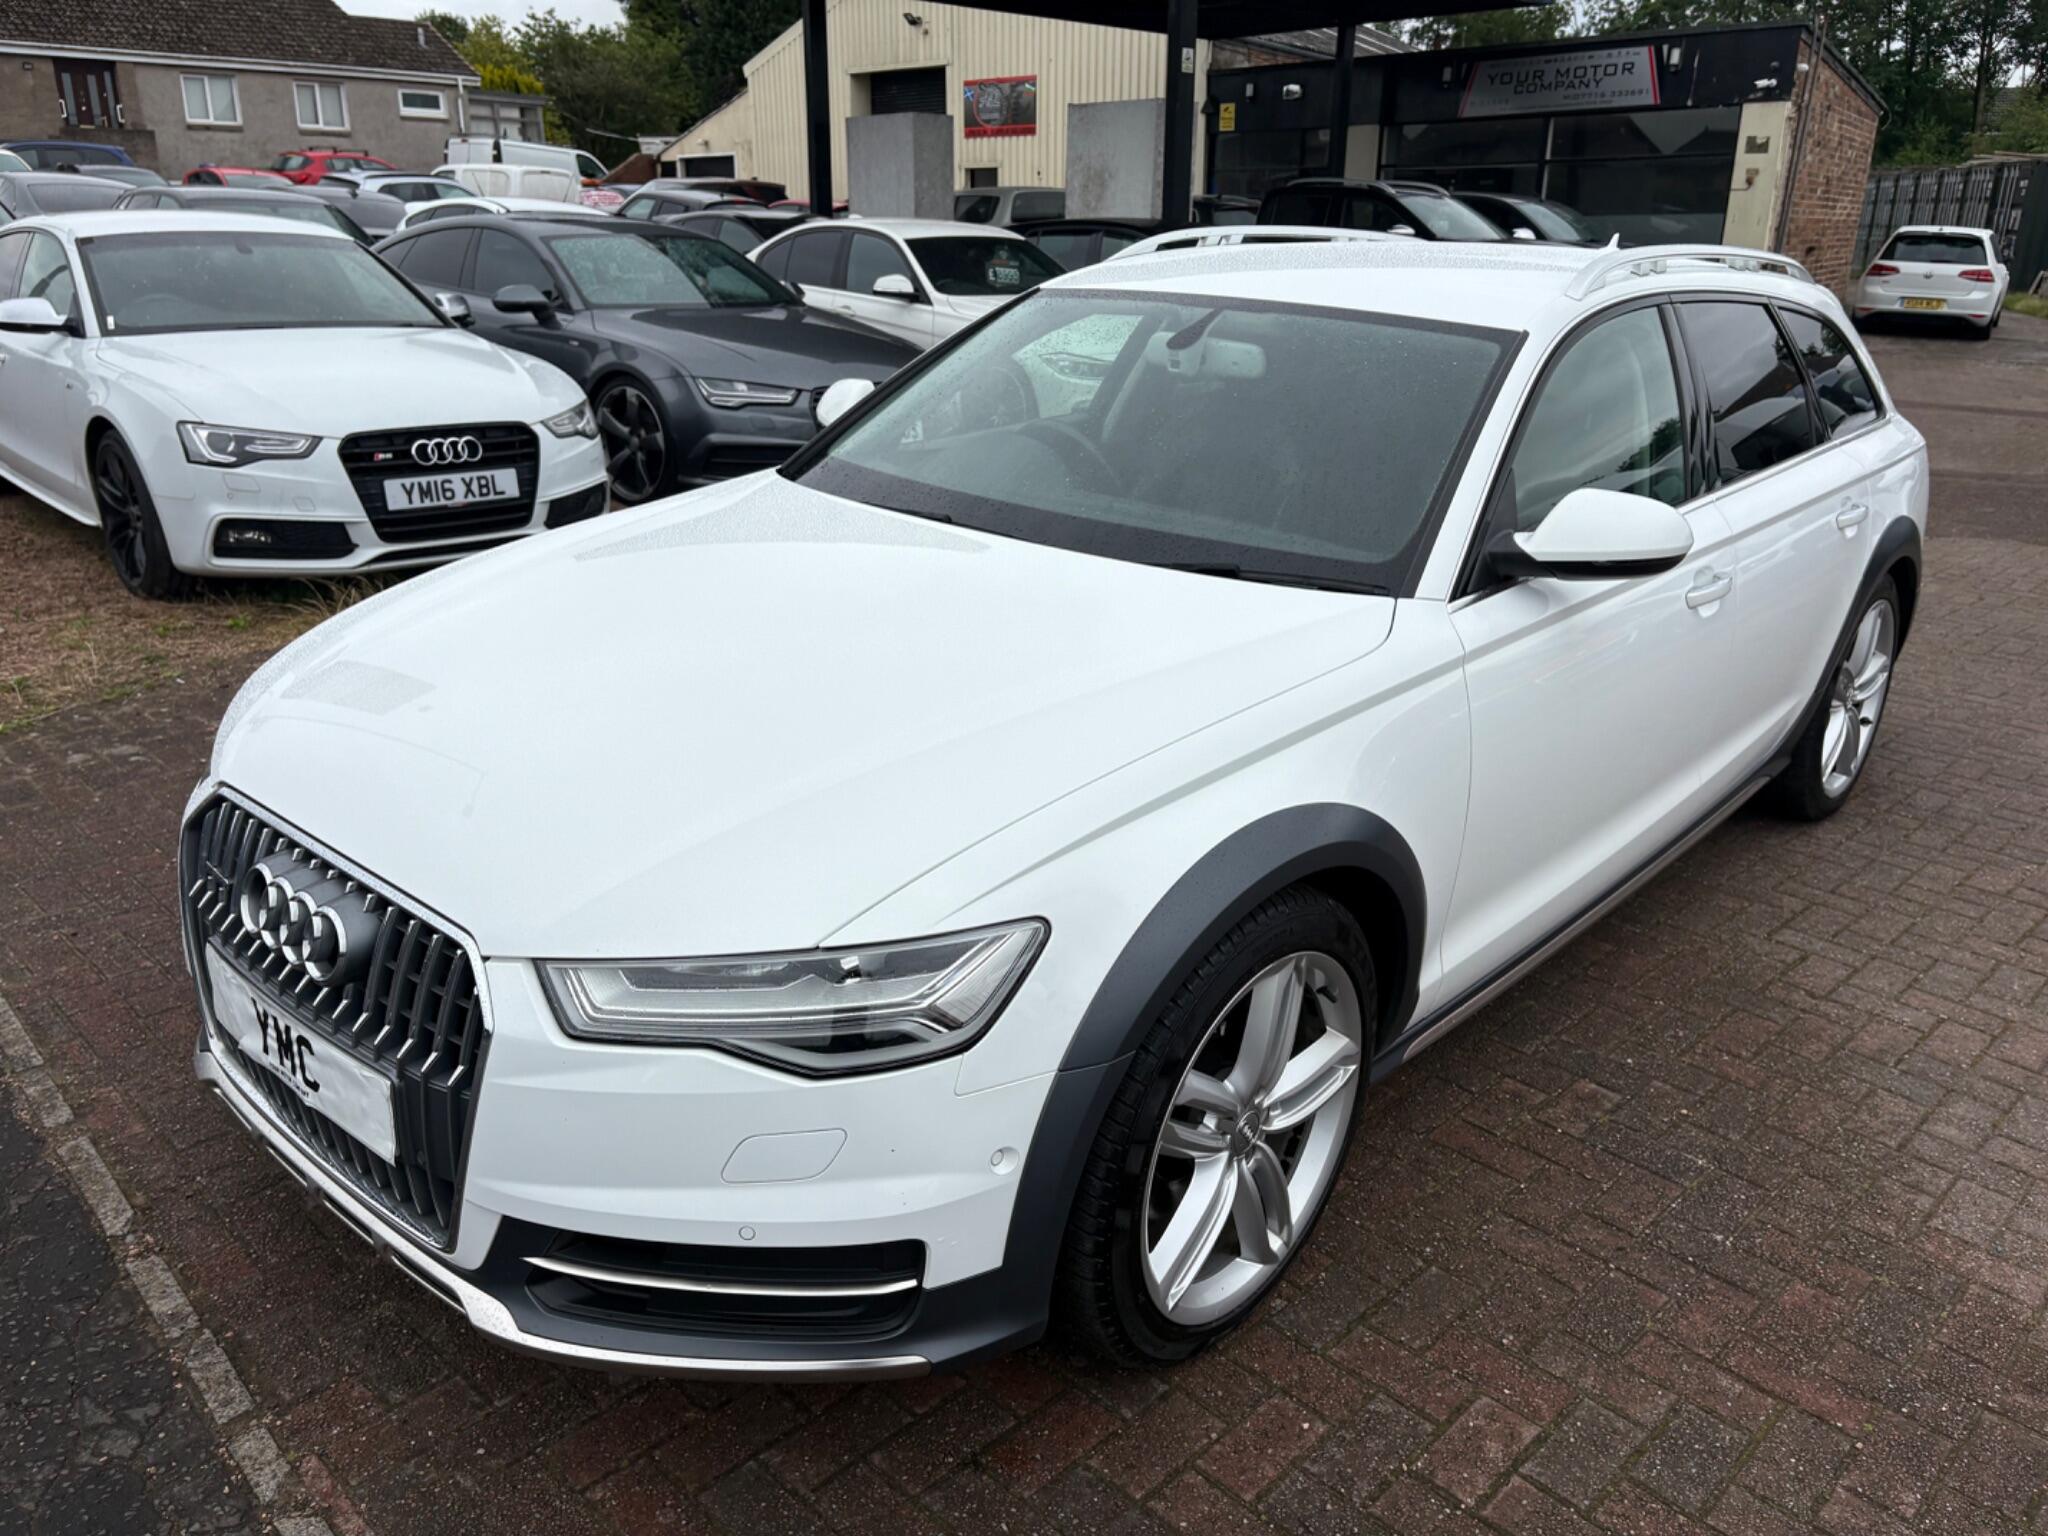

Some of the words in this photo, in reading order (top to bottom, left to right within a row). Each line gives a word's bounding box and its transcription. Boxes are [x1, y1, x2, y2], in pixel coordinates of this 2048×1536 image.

[1488, 69, 1545, 86] YOUR
[1555, 61, 1635, 80] MOTOR
[1513, 77, 1603, 95] COMPANY
[401, 479, 456, 505] YM16
[460, 474, 507, 500] XBL
[251, 997, 321, 1093] YMC
